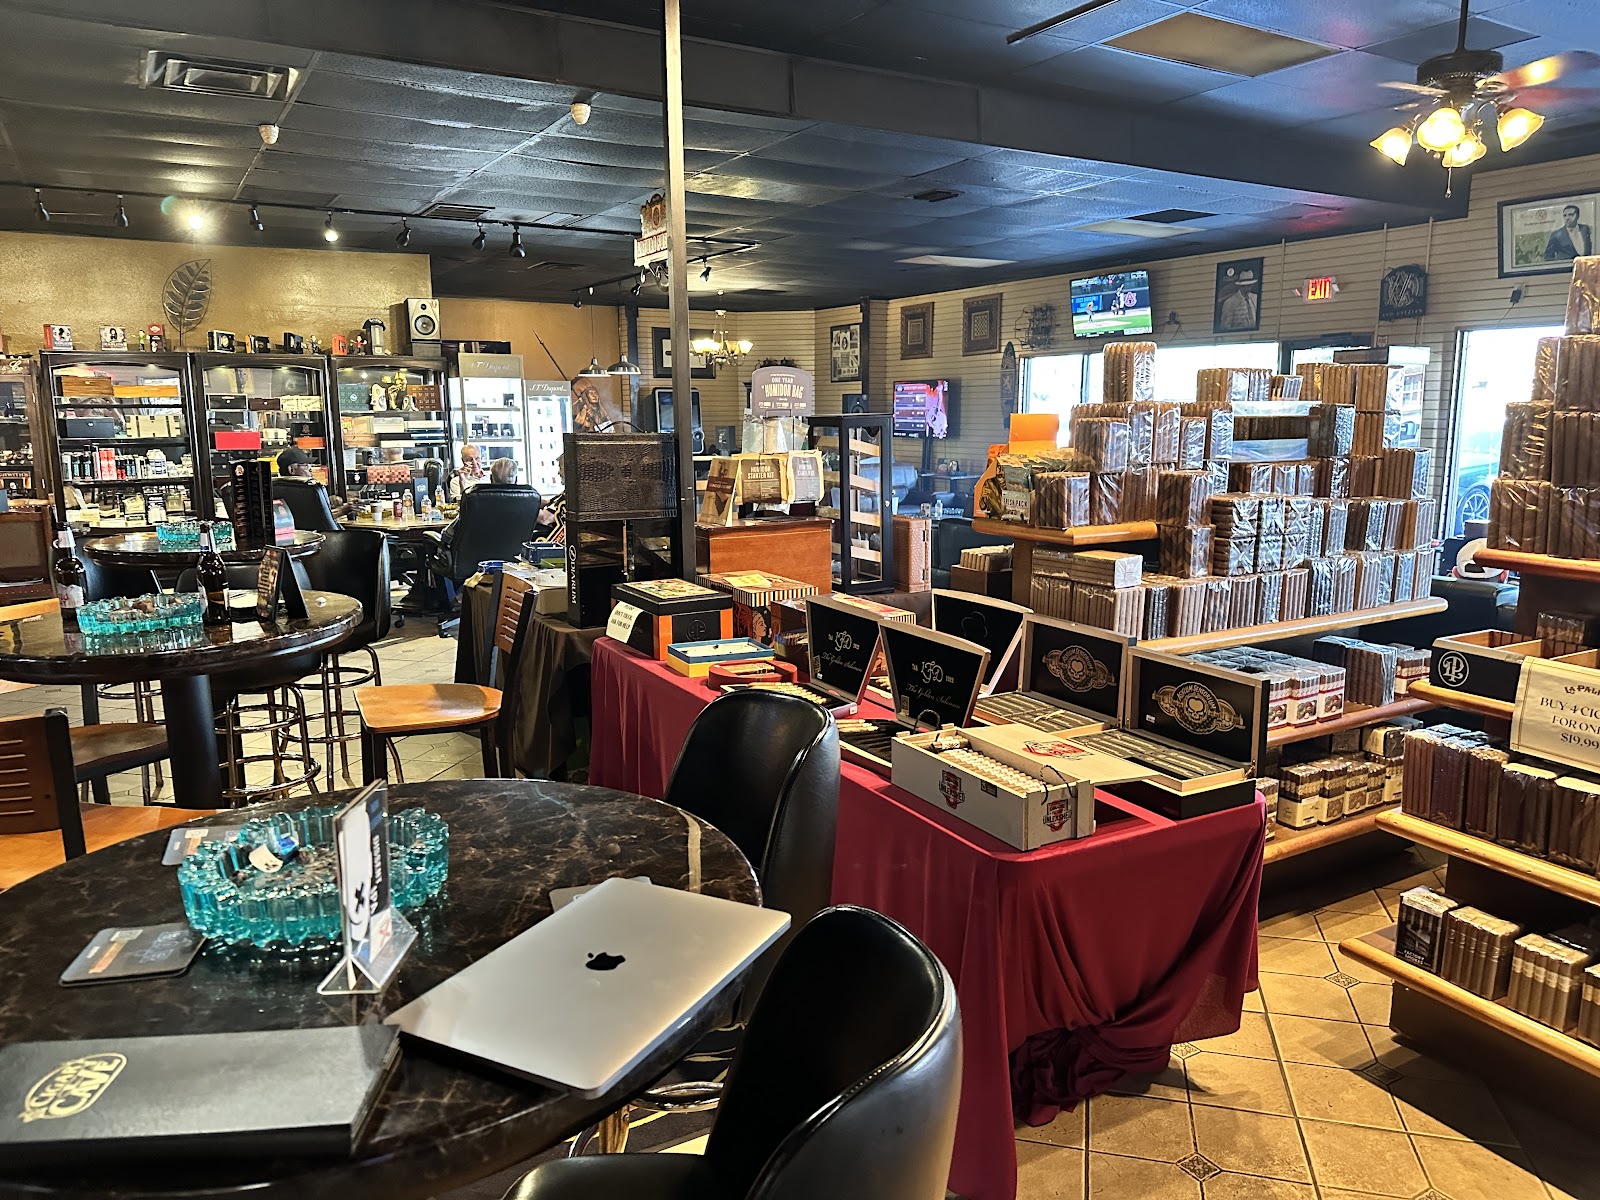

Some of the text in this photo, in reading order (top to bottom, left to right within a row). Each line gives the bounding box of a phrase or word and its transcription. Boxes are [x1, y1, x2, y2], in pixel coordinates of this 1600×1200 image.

[1308, 279, 1330, 299] EXIT
[1540, 697, 1568, 711] BUY
[1569, 705, 1580, 714] 4
[1551, 715, 1577, 729] FOR
[1560, 732, 1599, 750] $19.99
[48, 1058, 121, 1116] CAVE
